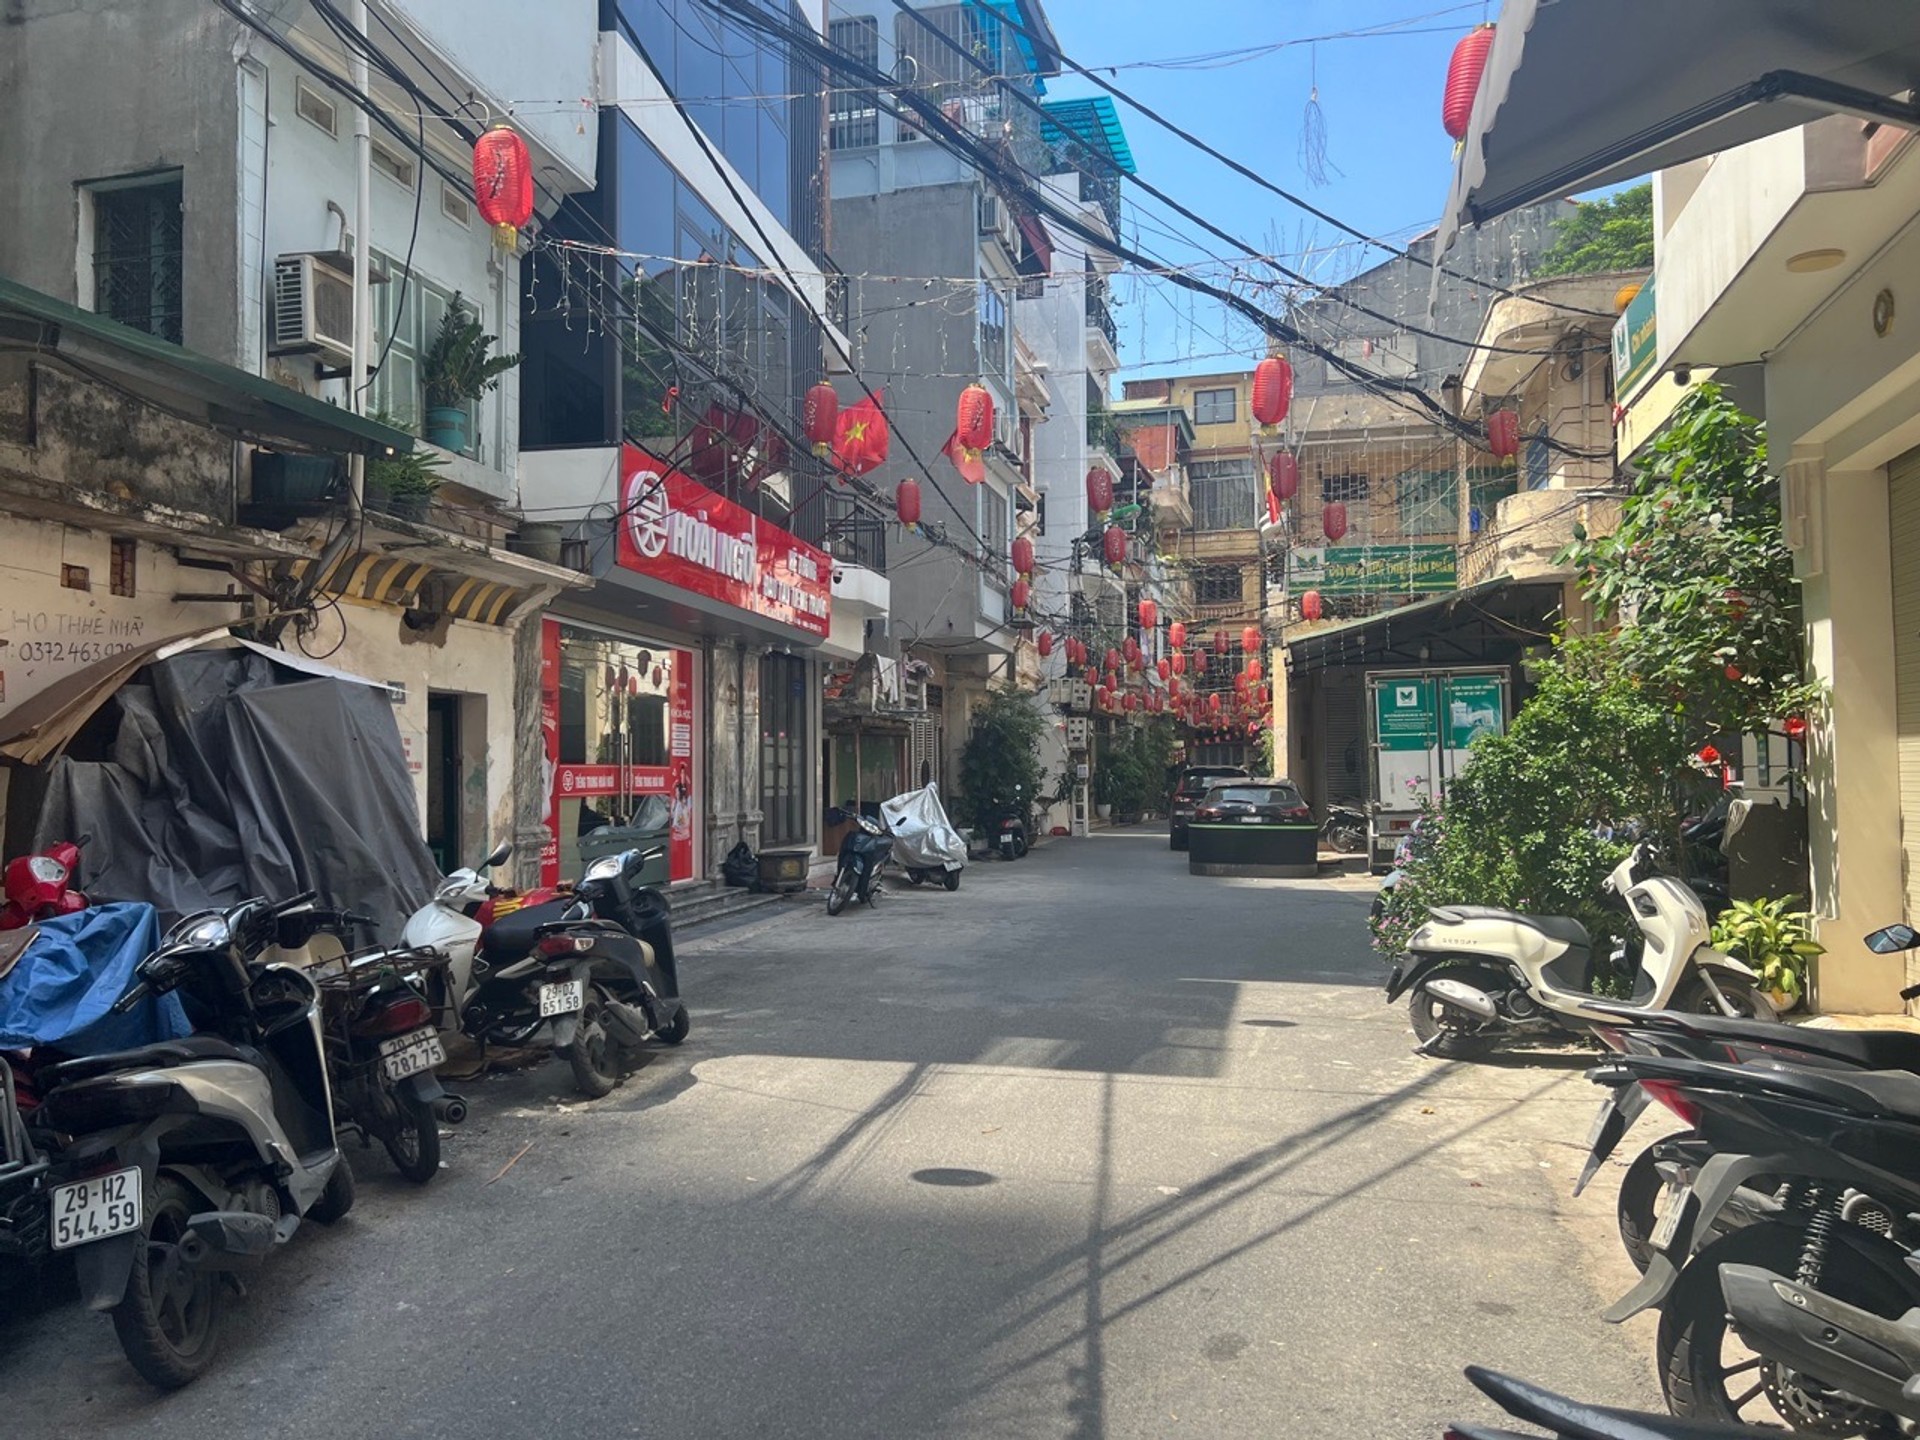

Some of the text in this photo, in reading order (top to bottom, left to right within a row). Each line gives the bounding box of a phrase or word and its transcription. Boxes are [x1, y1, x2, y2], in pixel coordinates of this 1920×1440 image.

[668, 509, 755, 586] HOÀI NGÔ
[390, 1045, 442, 1077] 282.75
[64, 1175, 126, 1213] 29-H2
[58, 1201, 135, 1243] 544.59
